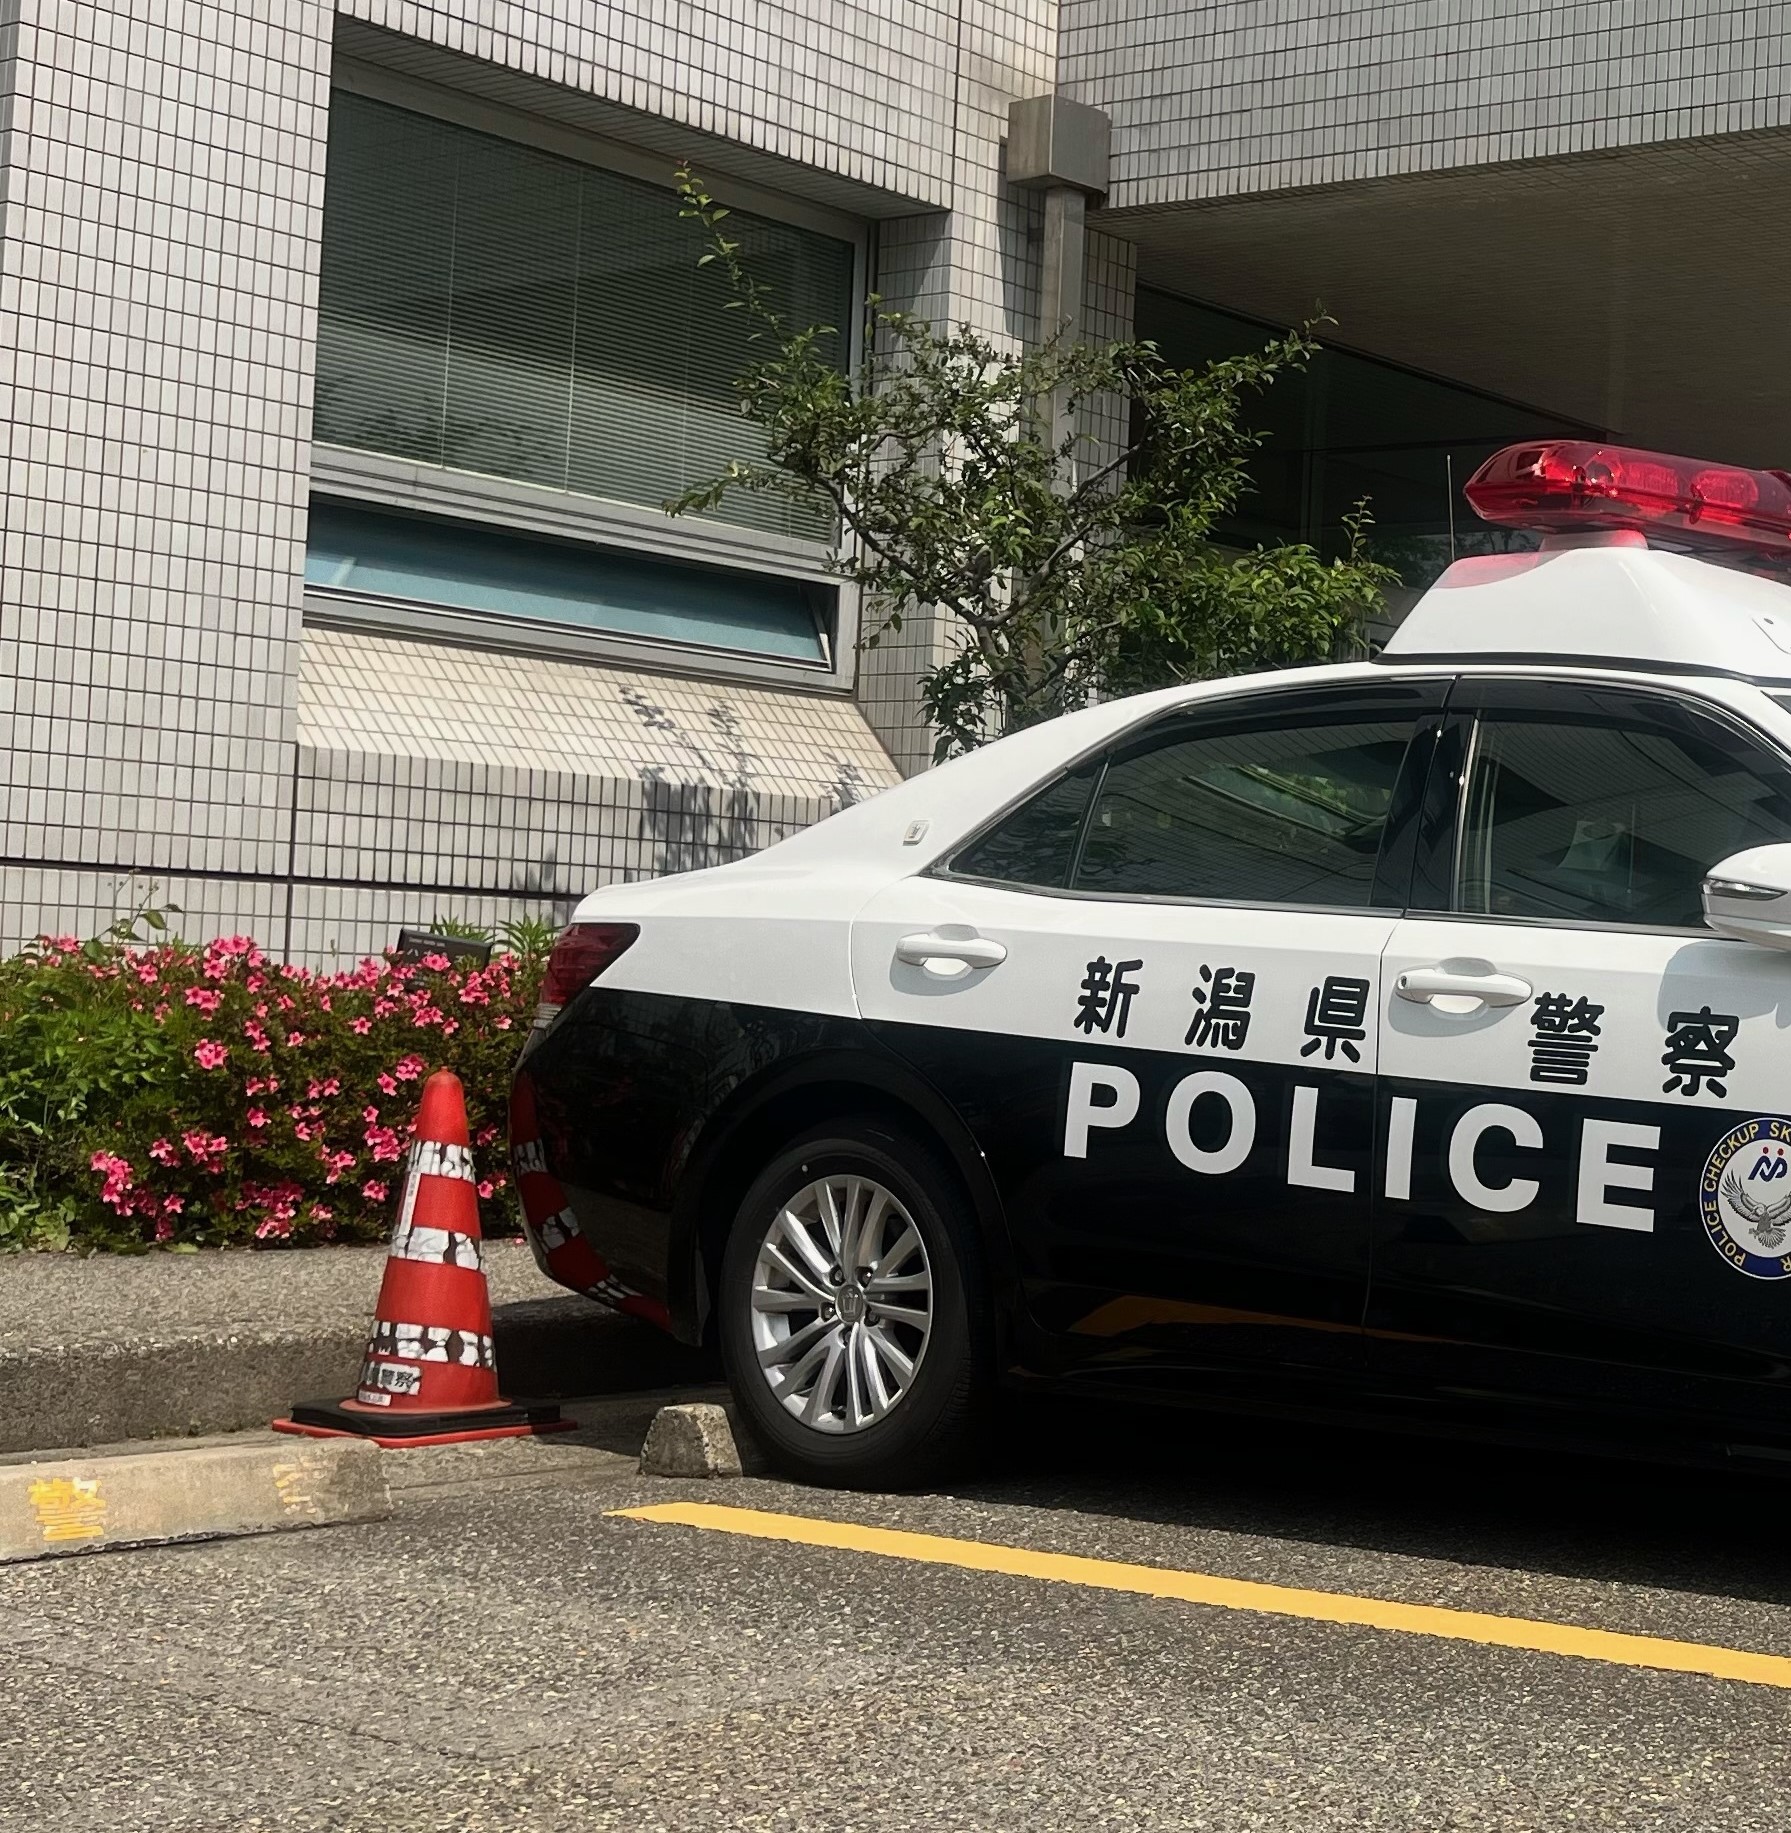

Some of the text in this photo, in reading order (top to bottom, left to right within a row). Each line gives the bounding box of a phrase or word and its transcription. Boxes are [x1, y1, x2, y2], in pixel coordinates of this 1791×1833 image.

[1062, 1059, 1662, 1235] POLICE
[1704, 1122, 1760, 1193] CHECKUP
[1704, 1199, 1747, 1267] POLICE
